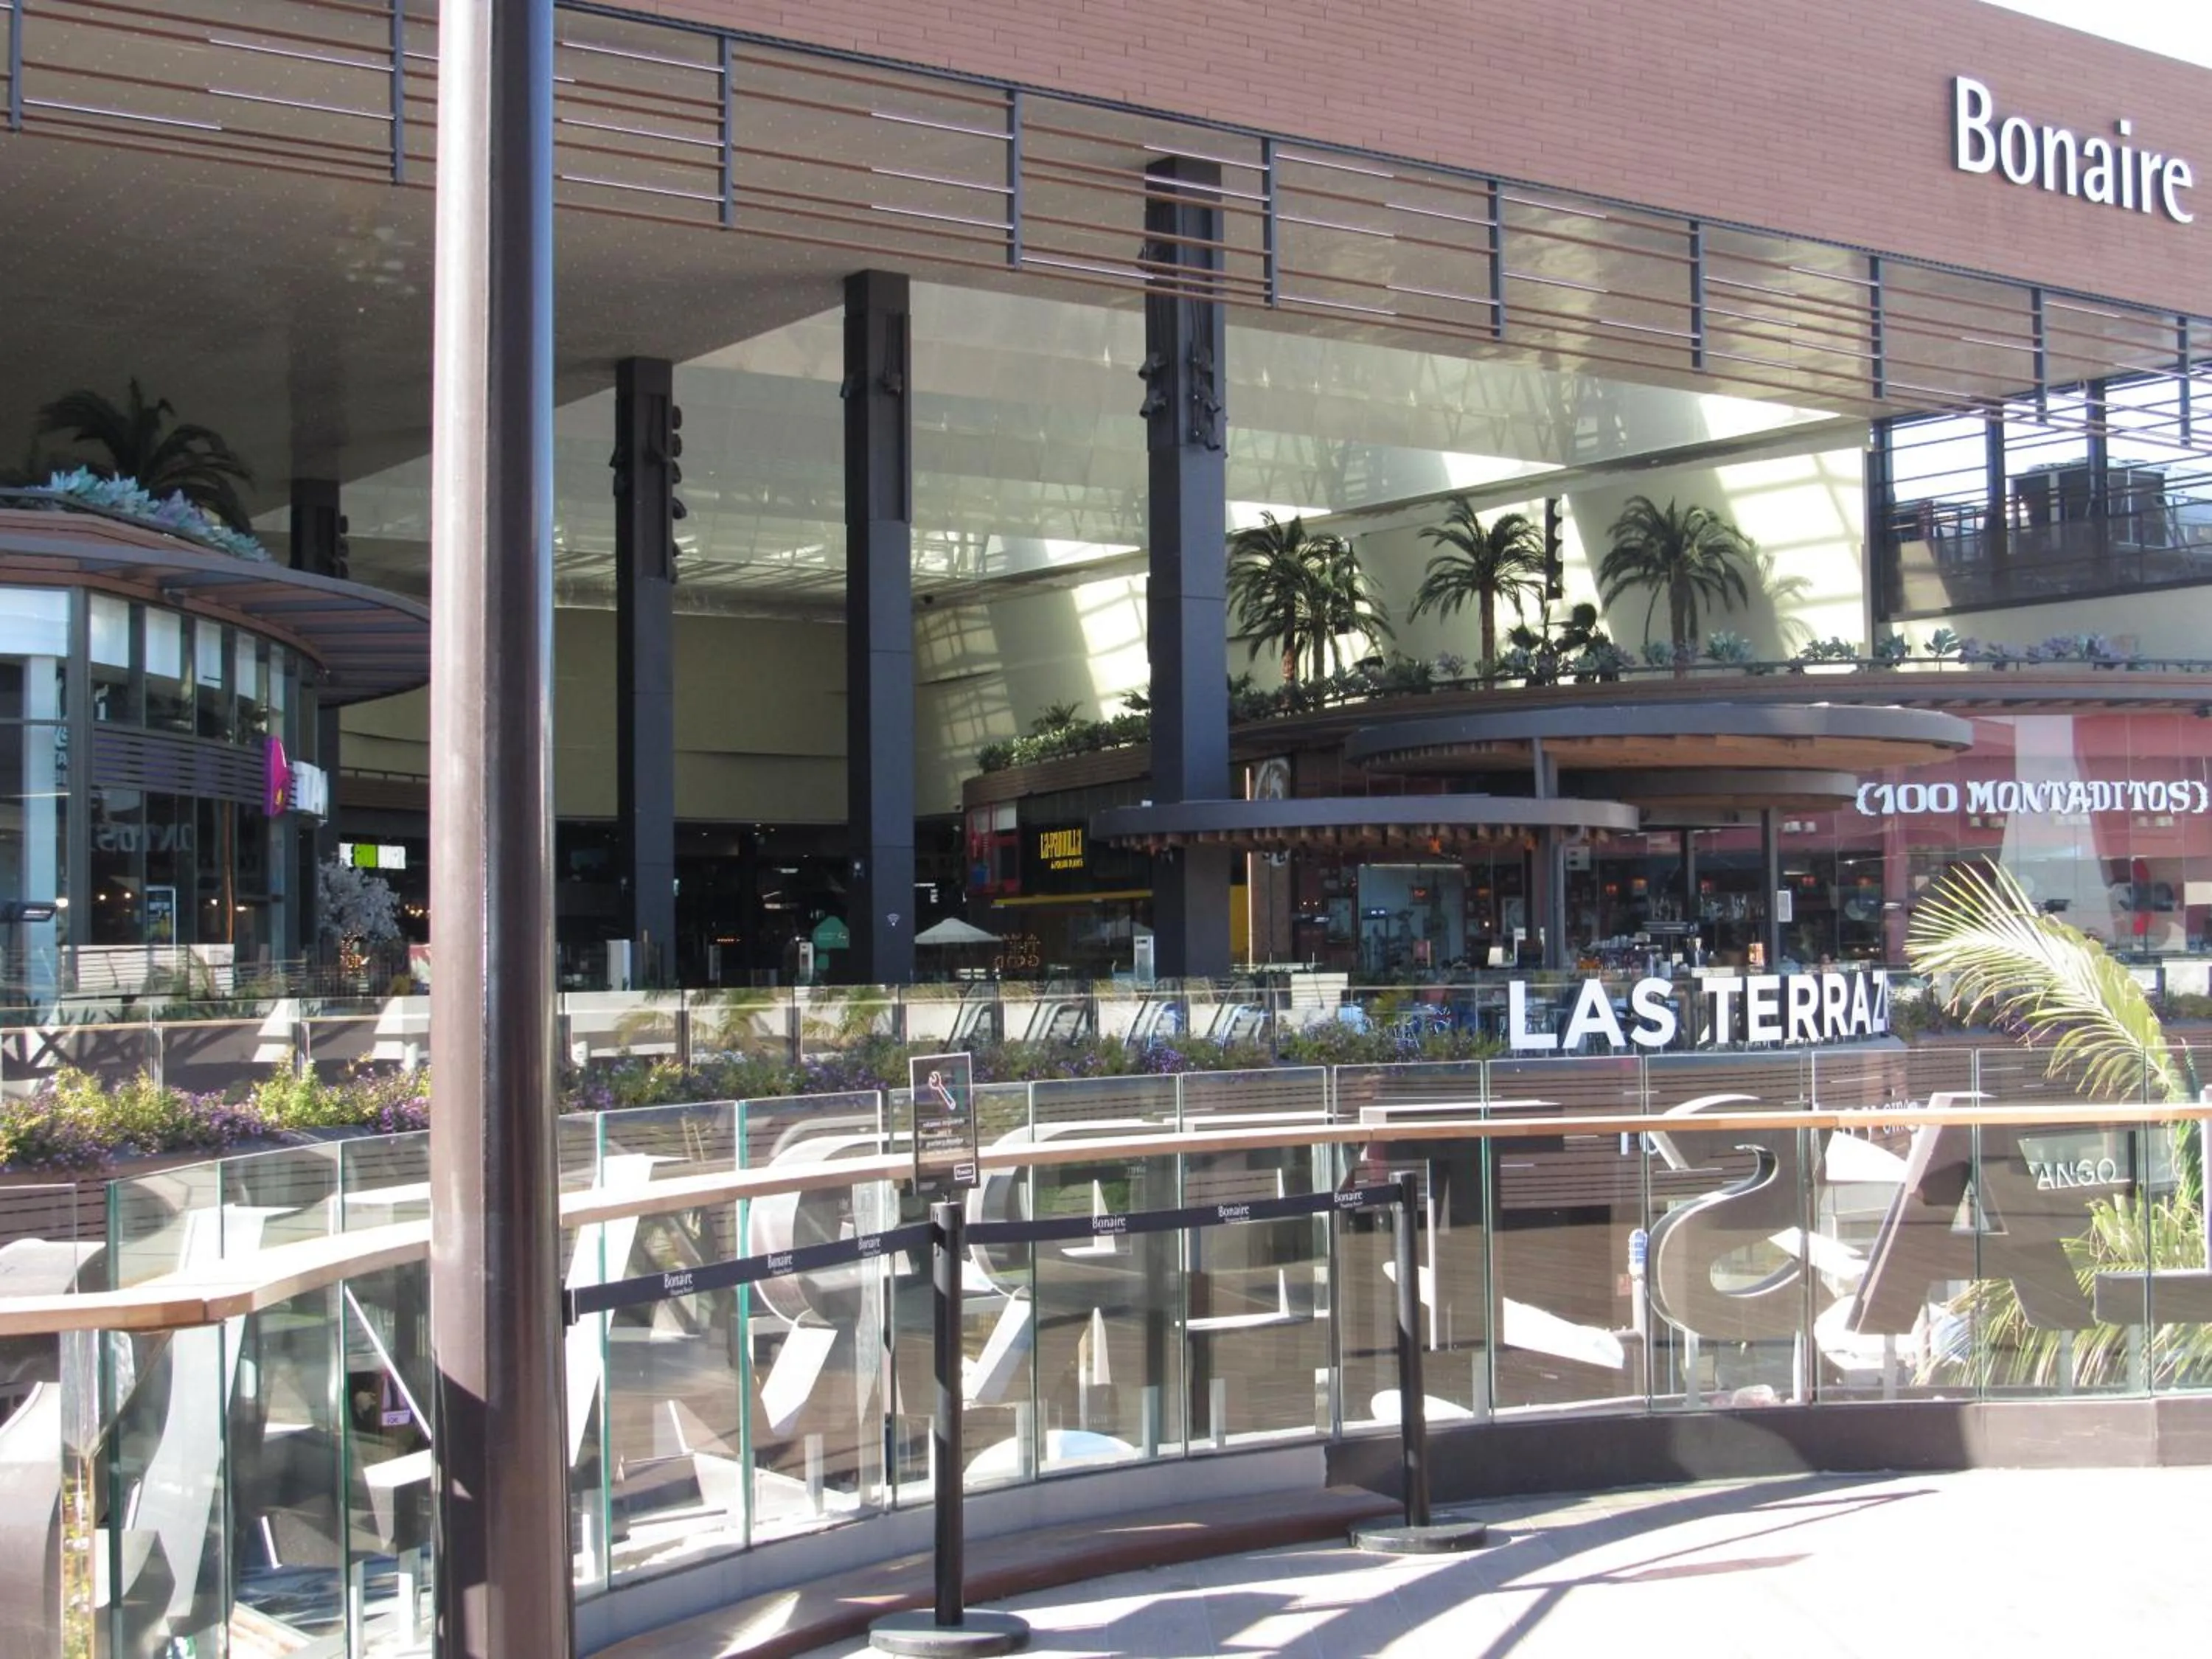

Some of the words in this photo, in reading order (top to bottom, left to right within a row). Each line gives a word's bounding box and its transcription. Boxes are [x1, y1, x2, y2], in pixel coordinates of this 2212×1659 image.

[1953, 75, 2194, 223] Bonaire
[1509, 977, 1676, 1049] LAS
[1702, 970, 1889, 1044] TERRAZ
[2029, 1158, 2117, 1190] ANGO
[1334, 1190, 1363, 1203] Bonaire
[1218, 1204, 1250, 1217] Bonaire
[1092, 1215, 1127, 1229] Bonaire
[858, 1236, 881, 1251] Bonaire
[768, 1251, 793, 1269] Bonaire
[664, 1271, 693, 1288] Bonaire
